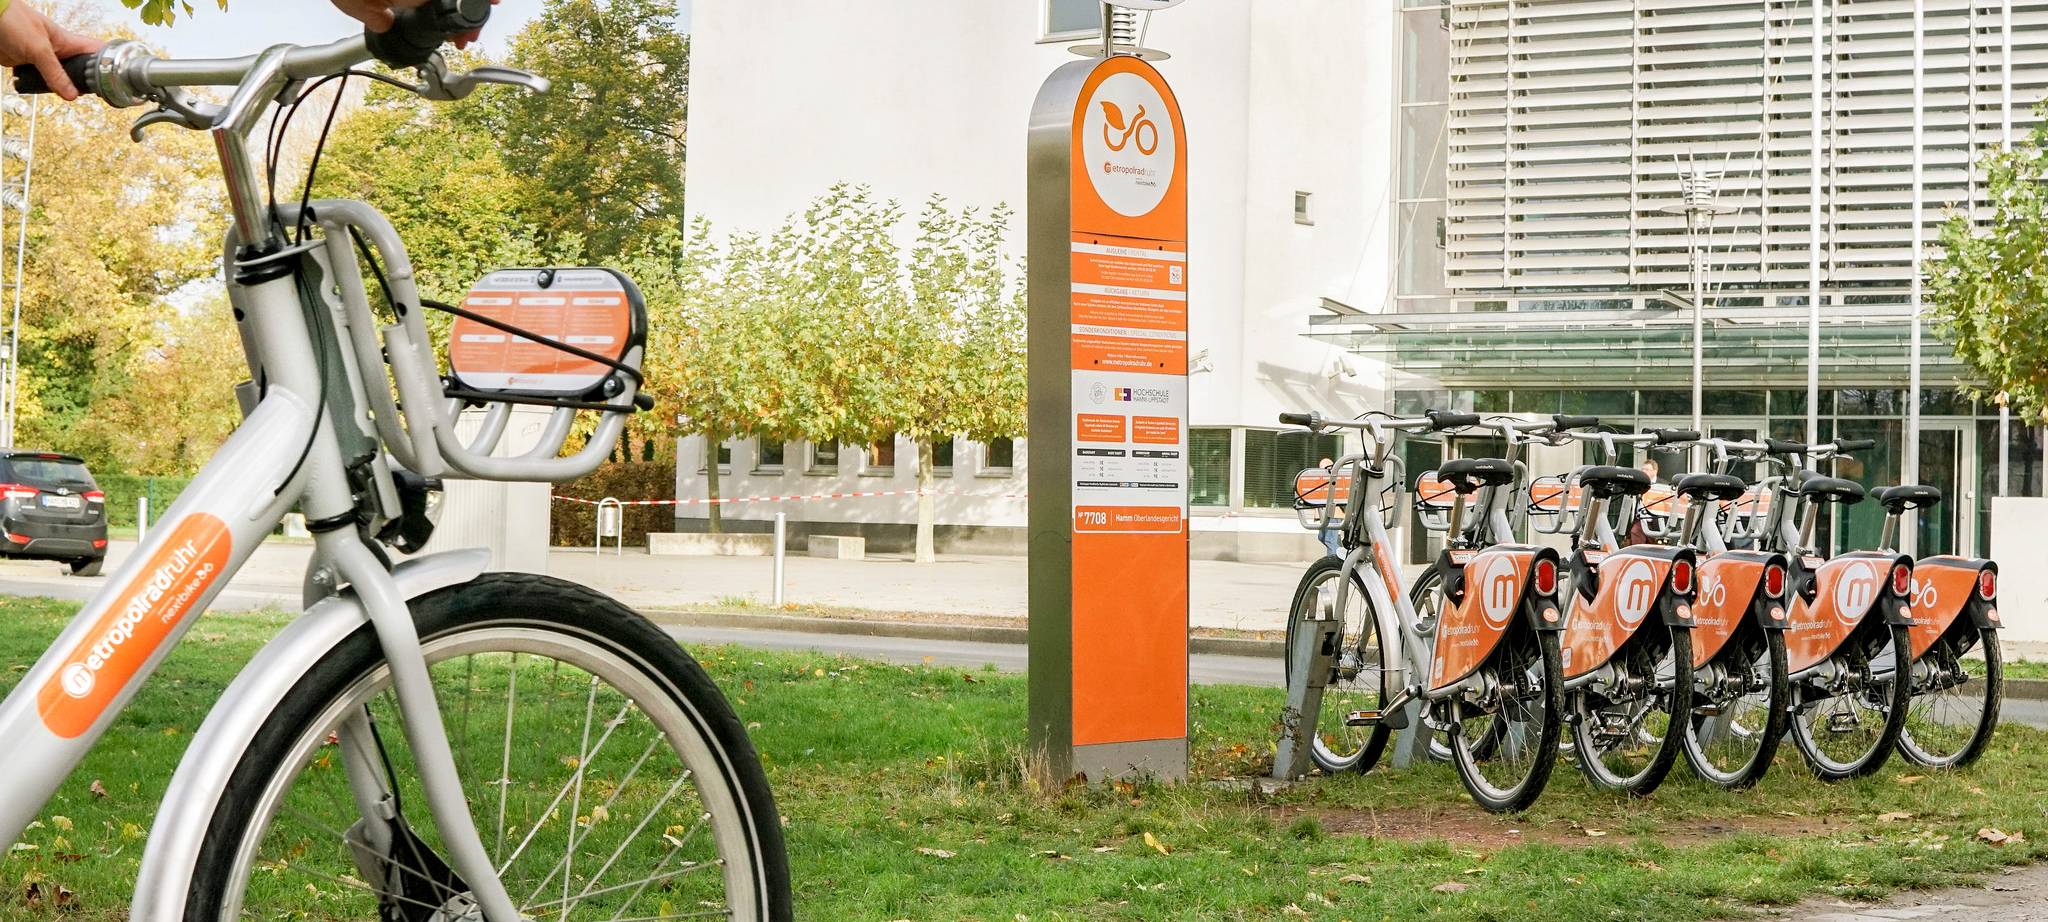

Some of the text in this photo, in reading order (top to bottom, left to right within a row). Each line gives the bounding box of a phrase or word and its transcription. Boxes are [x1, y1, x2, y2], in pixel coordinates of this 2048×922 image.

[1084, 511, 1107, 525] 7708
[1115, 514, 1133, 522] Hamm
[1133, 514, 1179, 524] Oberlandesgericht
[161, 577, 203, 624] nextbike
